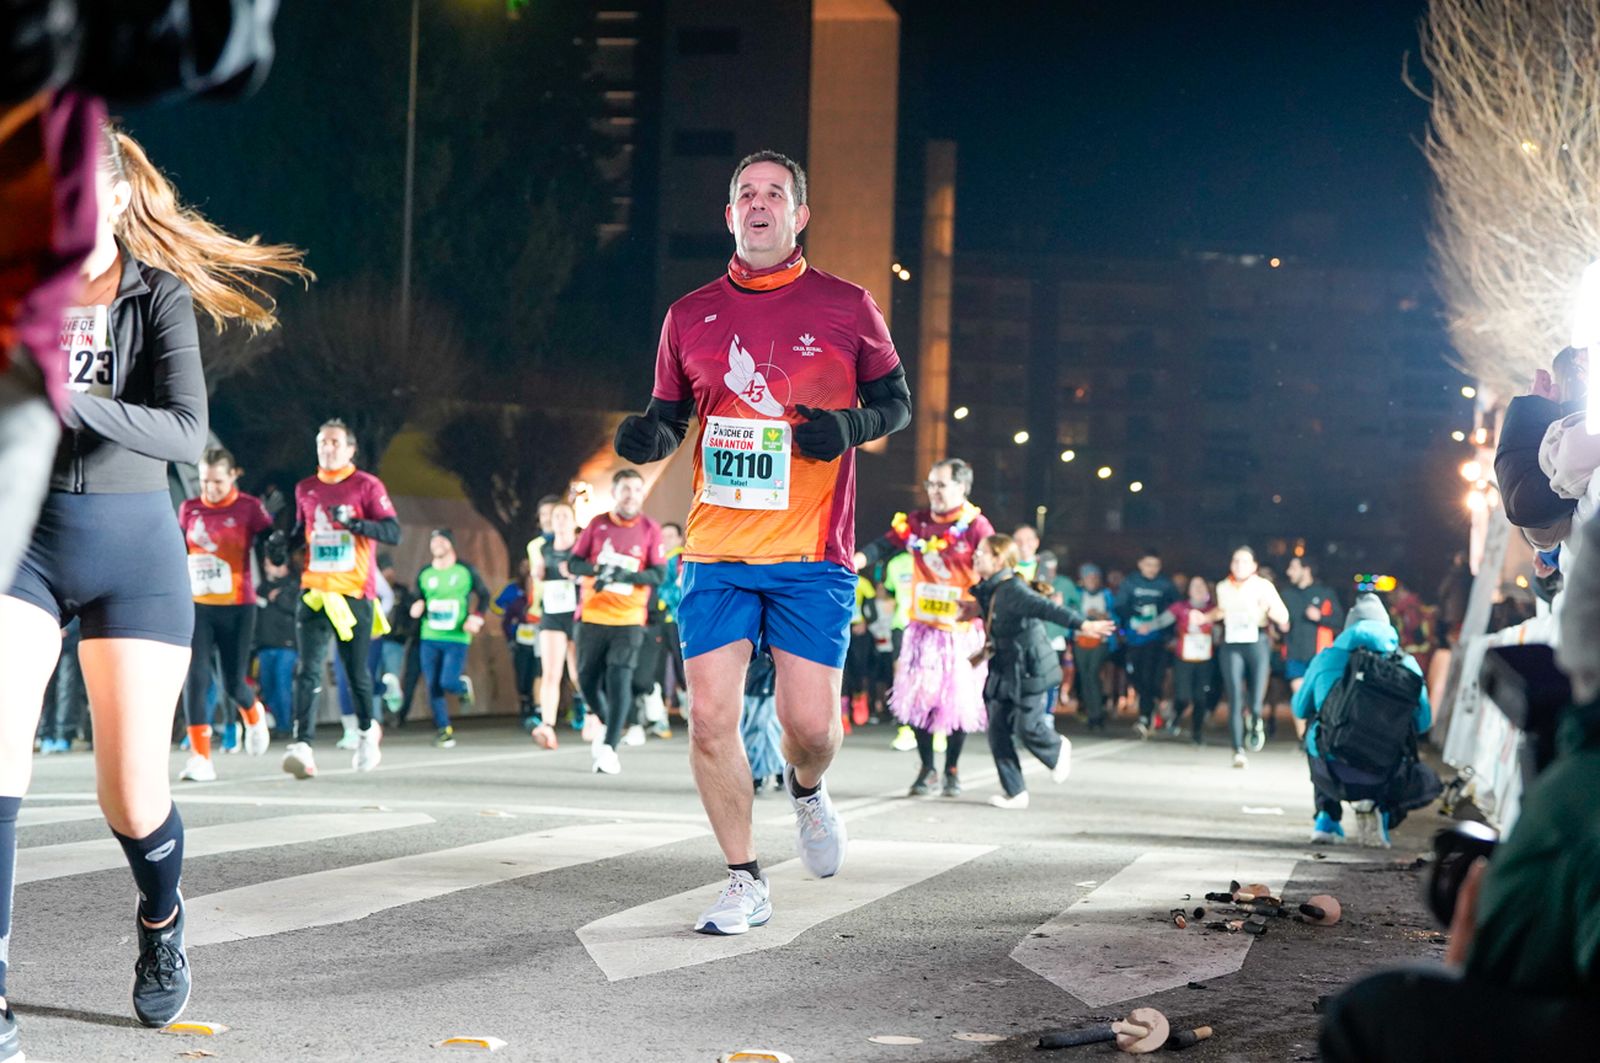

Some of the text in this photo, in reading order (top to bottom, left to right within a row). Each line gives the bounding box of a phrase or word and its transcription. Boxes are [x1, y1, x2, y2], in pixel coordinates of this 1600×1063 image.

[741, 380, 766, 403] 43
[718, 428, 754, 439] NOCHE DE
[709, 437, 724, 448] SAN
[724, 438, 754, 450] ANTÓN
[713, 450, 773, 479] 12110
